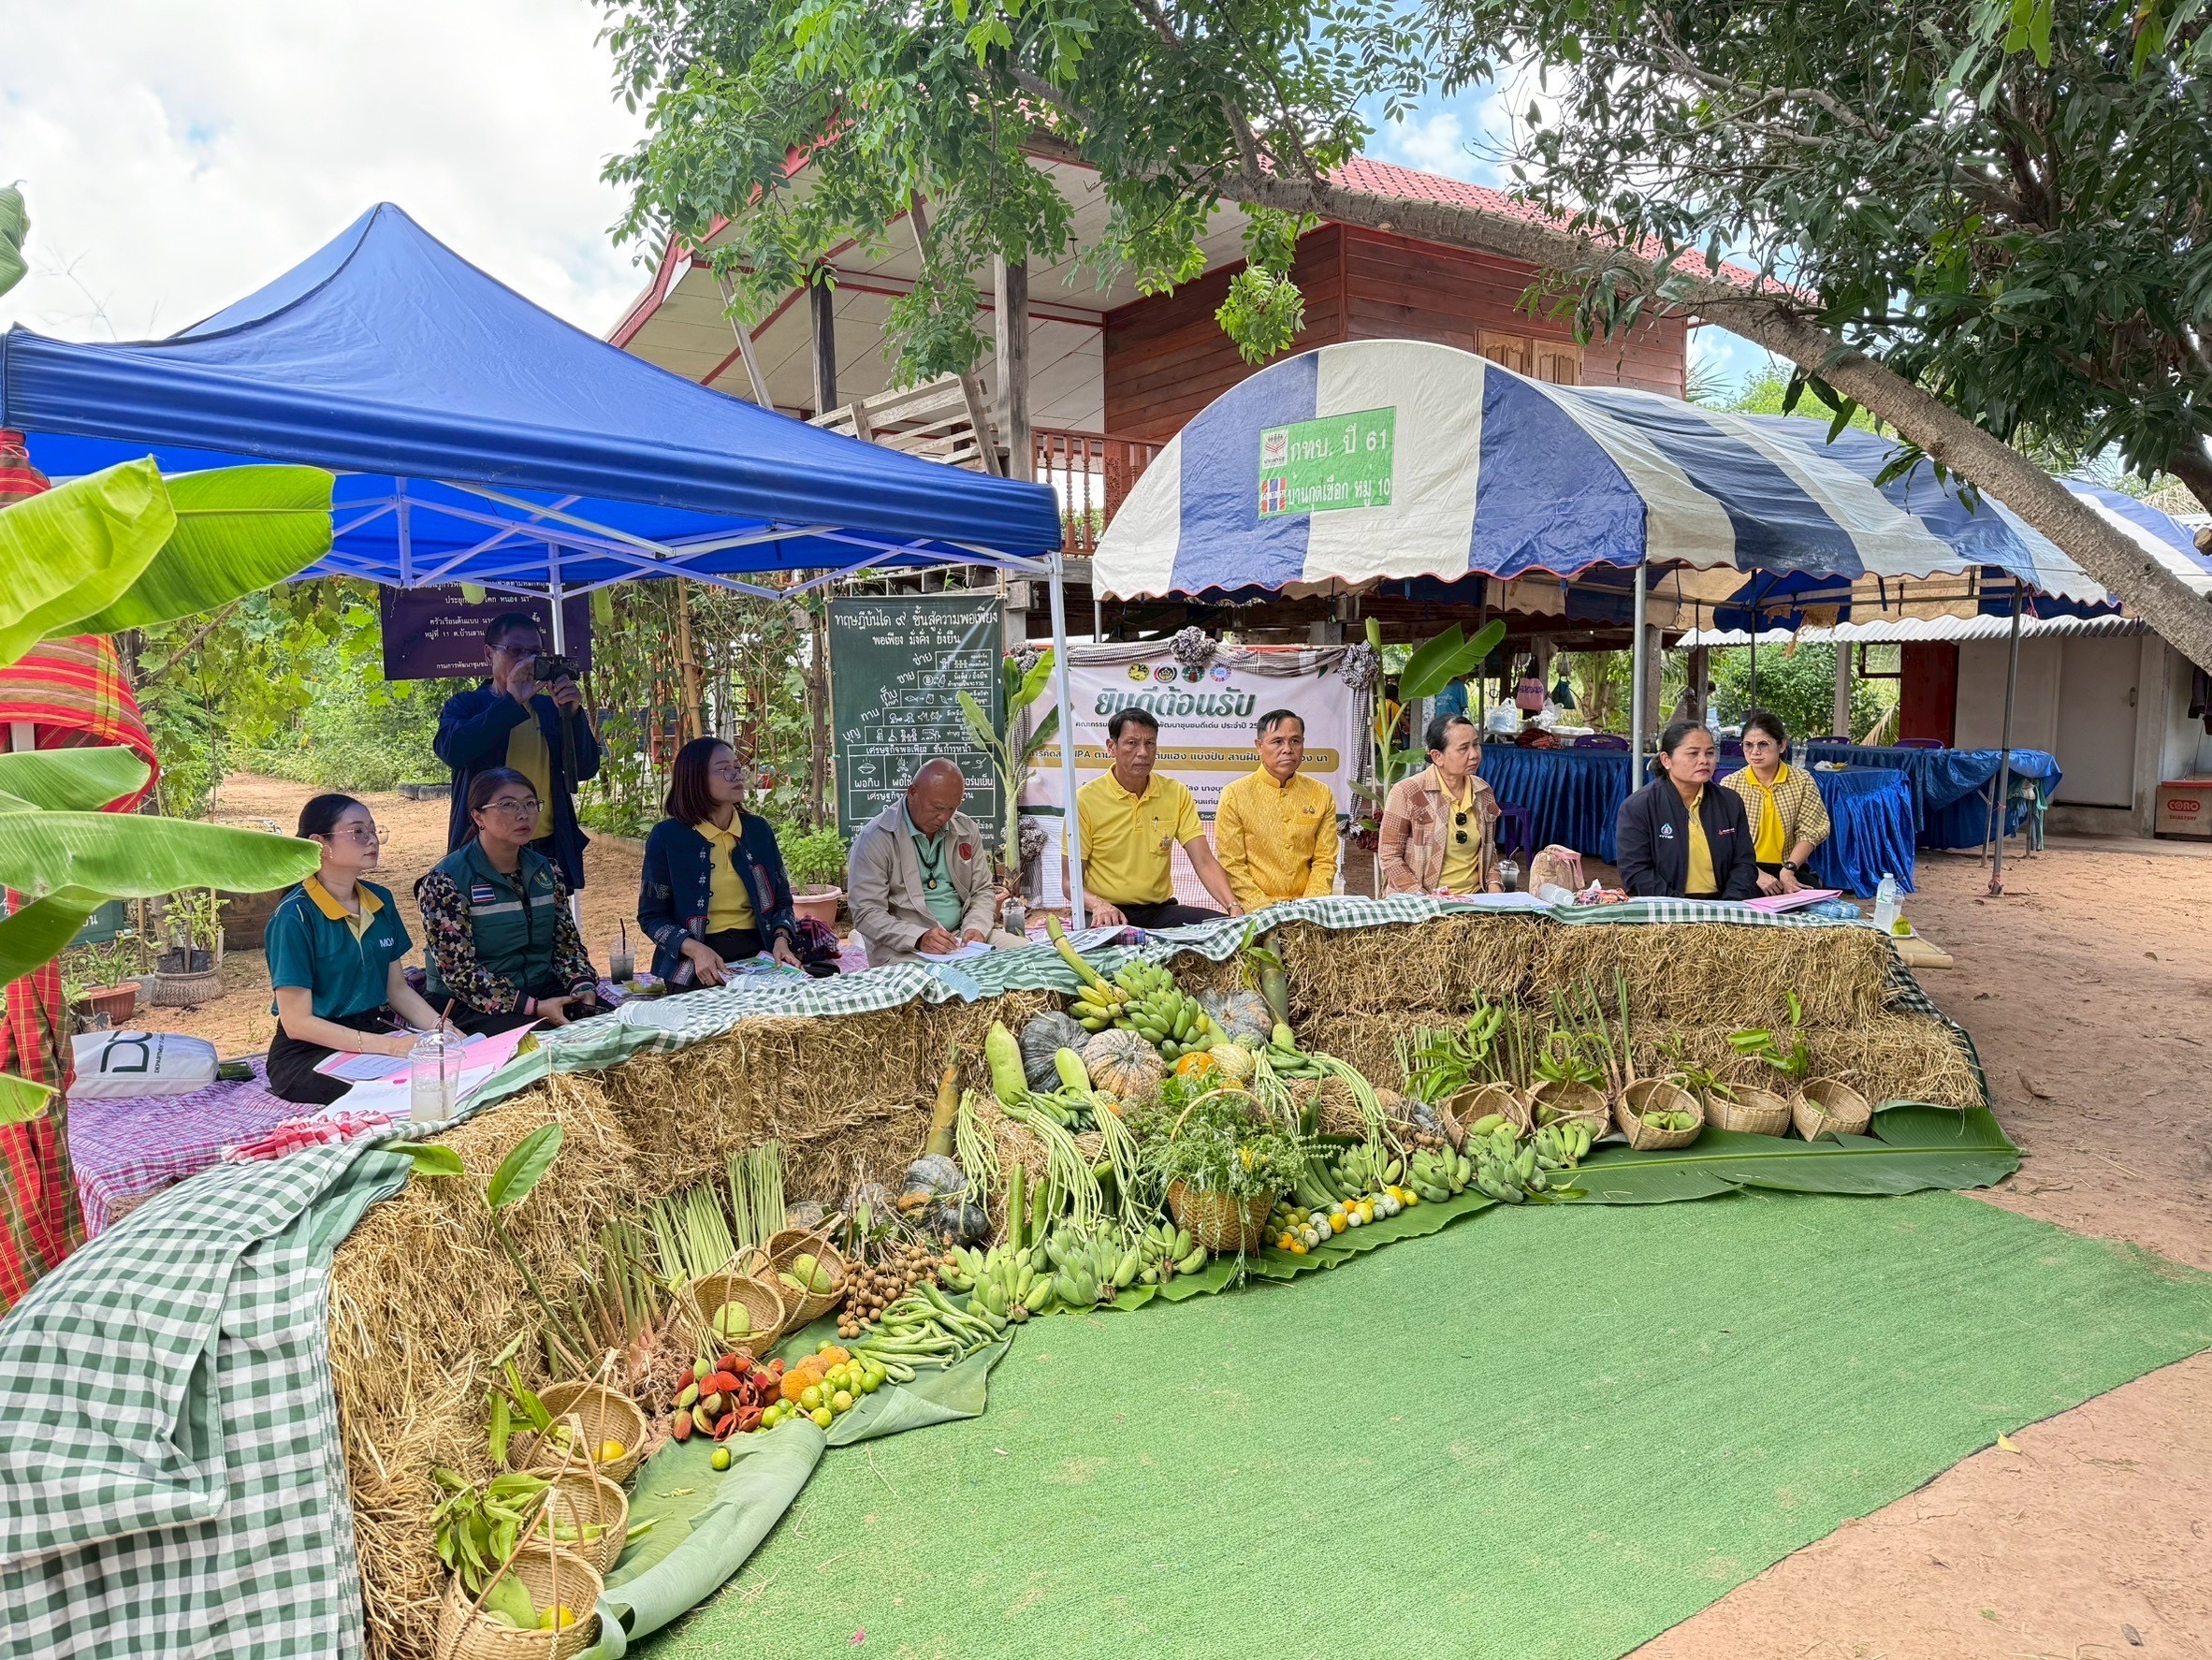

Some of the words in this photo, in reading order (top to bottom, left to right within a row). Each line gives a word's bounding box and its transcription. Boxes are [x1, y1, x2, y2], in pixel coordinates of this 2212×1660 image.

[1290, 437, 1333, 462] กทบ.
[1344, 423, 1357, 455] ปี
[1366, 429, 1387, 451] 61
[1378, 478, 1390, 497] 10
[895, 611, 907, 627] ๙
[912, 604, 998, 633] ขั้นสู่ความพอเพียง
[872, 633, 904, 646] พอเพียง
[909, 628, 930, 646] มั่งคั่ง
[937, 628, 961, 645] ยั่งยืน
[1094, 685, 1257, 718] ยินดีต้อนรับ
[860, 707, 880, 721] ทาน
[842, 727, 862, 744] บุญ
[866, 743, 927, 755] เศรษฐกิจพอเพียง
[1074, 750, 1091, 758] IPA
[1191, 750, 1225, 761] แบ่งปัน
[1228, 751, 1260, 761] สานฝัน
[854, 777, 880, 788] พอกิน
[2169, 801, 2200, 811] CORO
